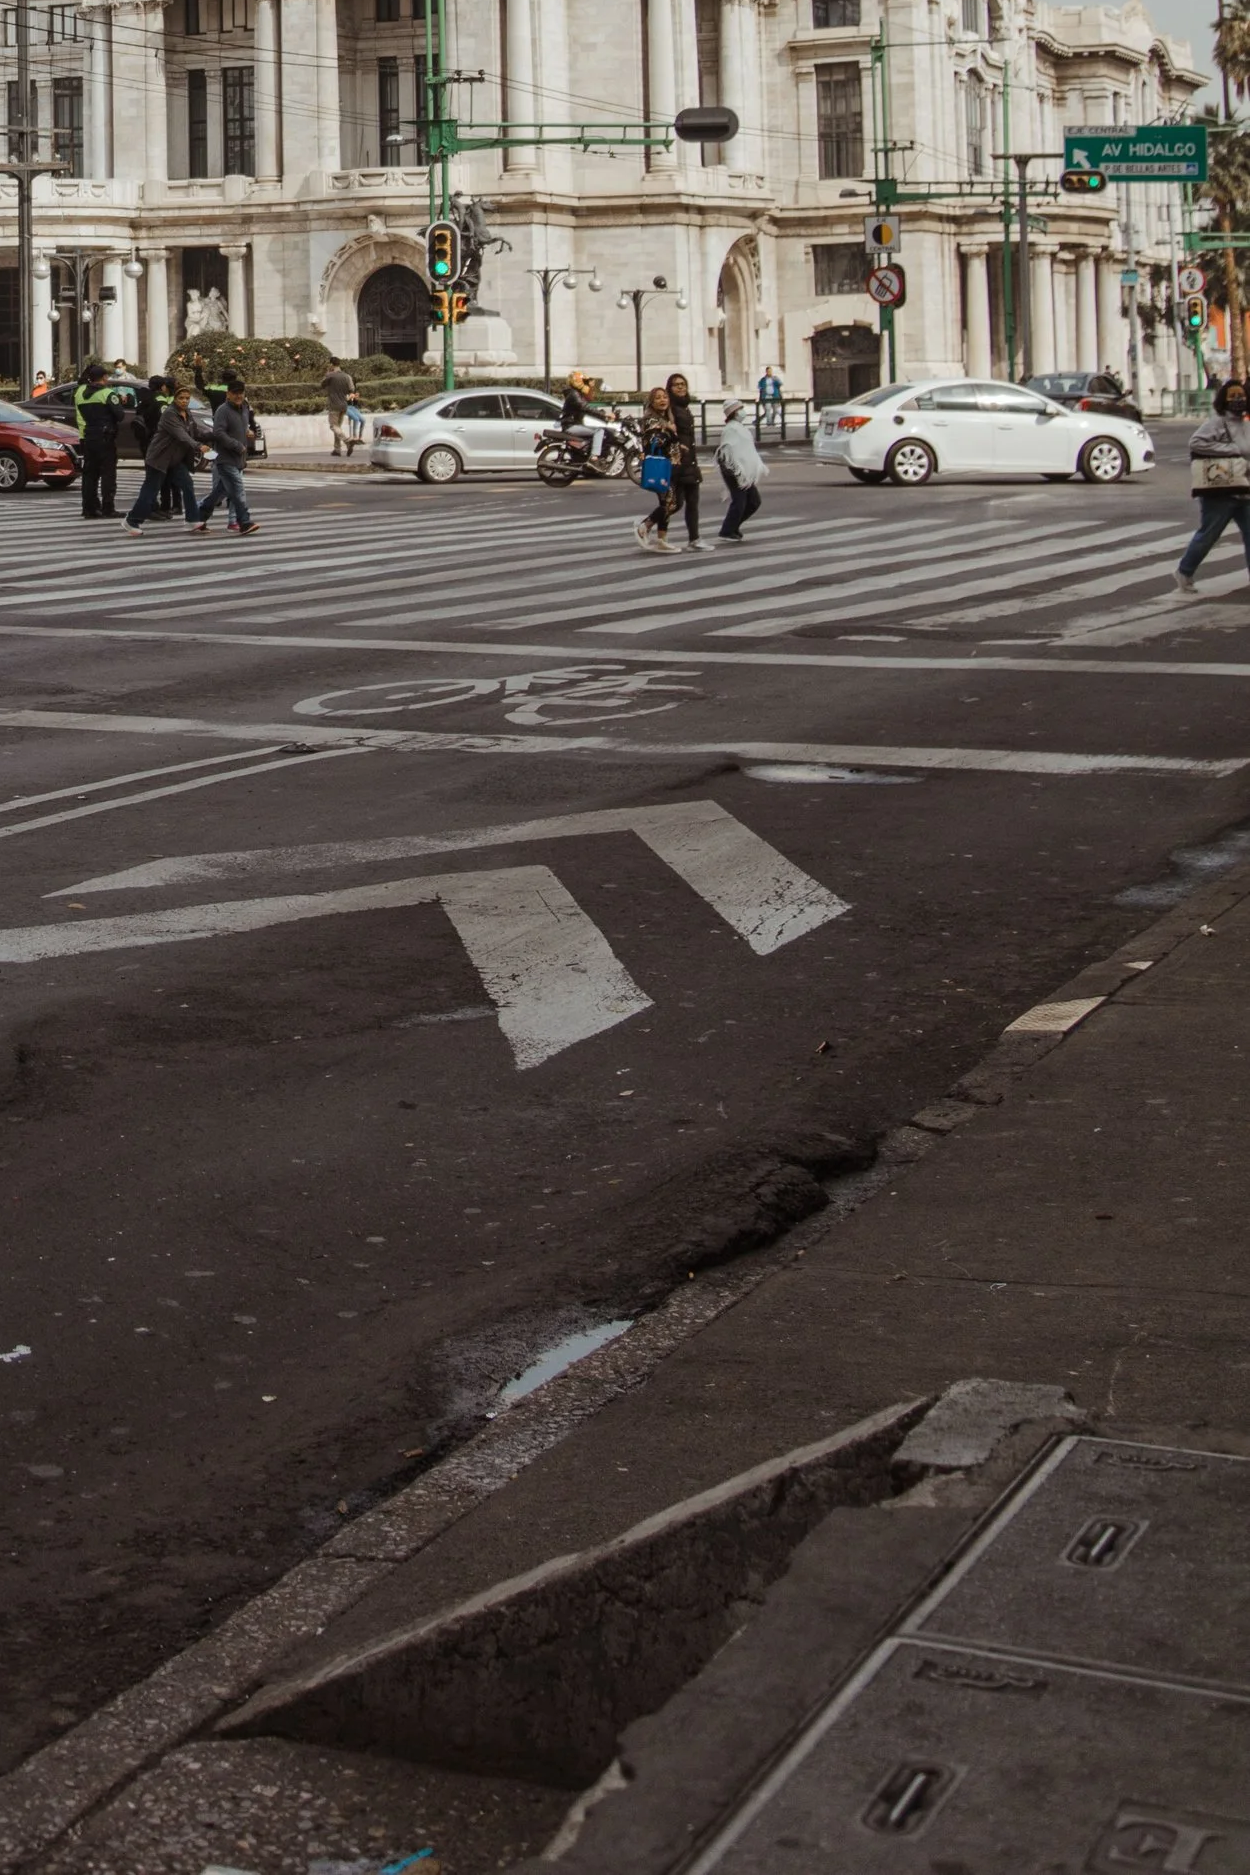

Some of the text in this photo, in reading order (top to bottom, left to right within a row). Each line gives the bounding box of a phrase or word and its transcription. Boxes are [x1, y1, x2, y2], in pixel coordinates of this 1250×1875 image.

[1067, 126, 1131, 135] EJE CENTRAL
[1101, 142, 1196, 157] AV HIDALGO
[1125, 164, 1154, 174] BELLAS
[1158, 164, 1182, 174] ARTES
